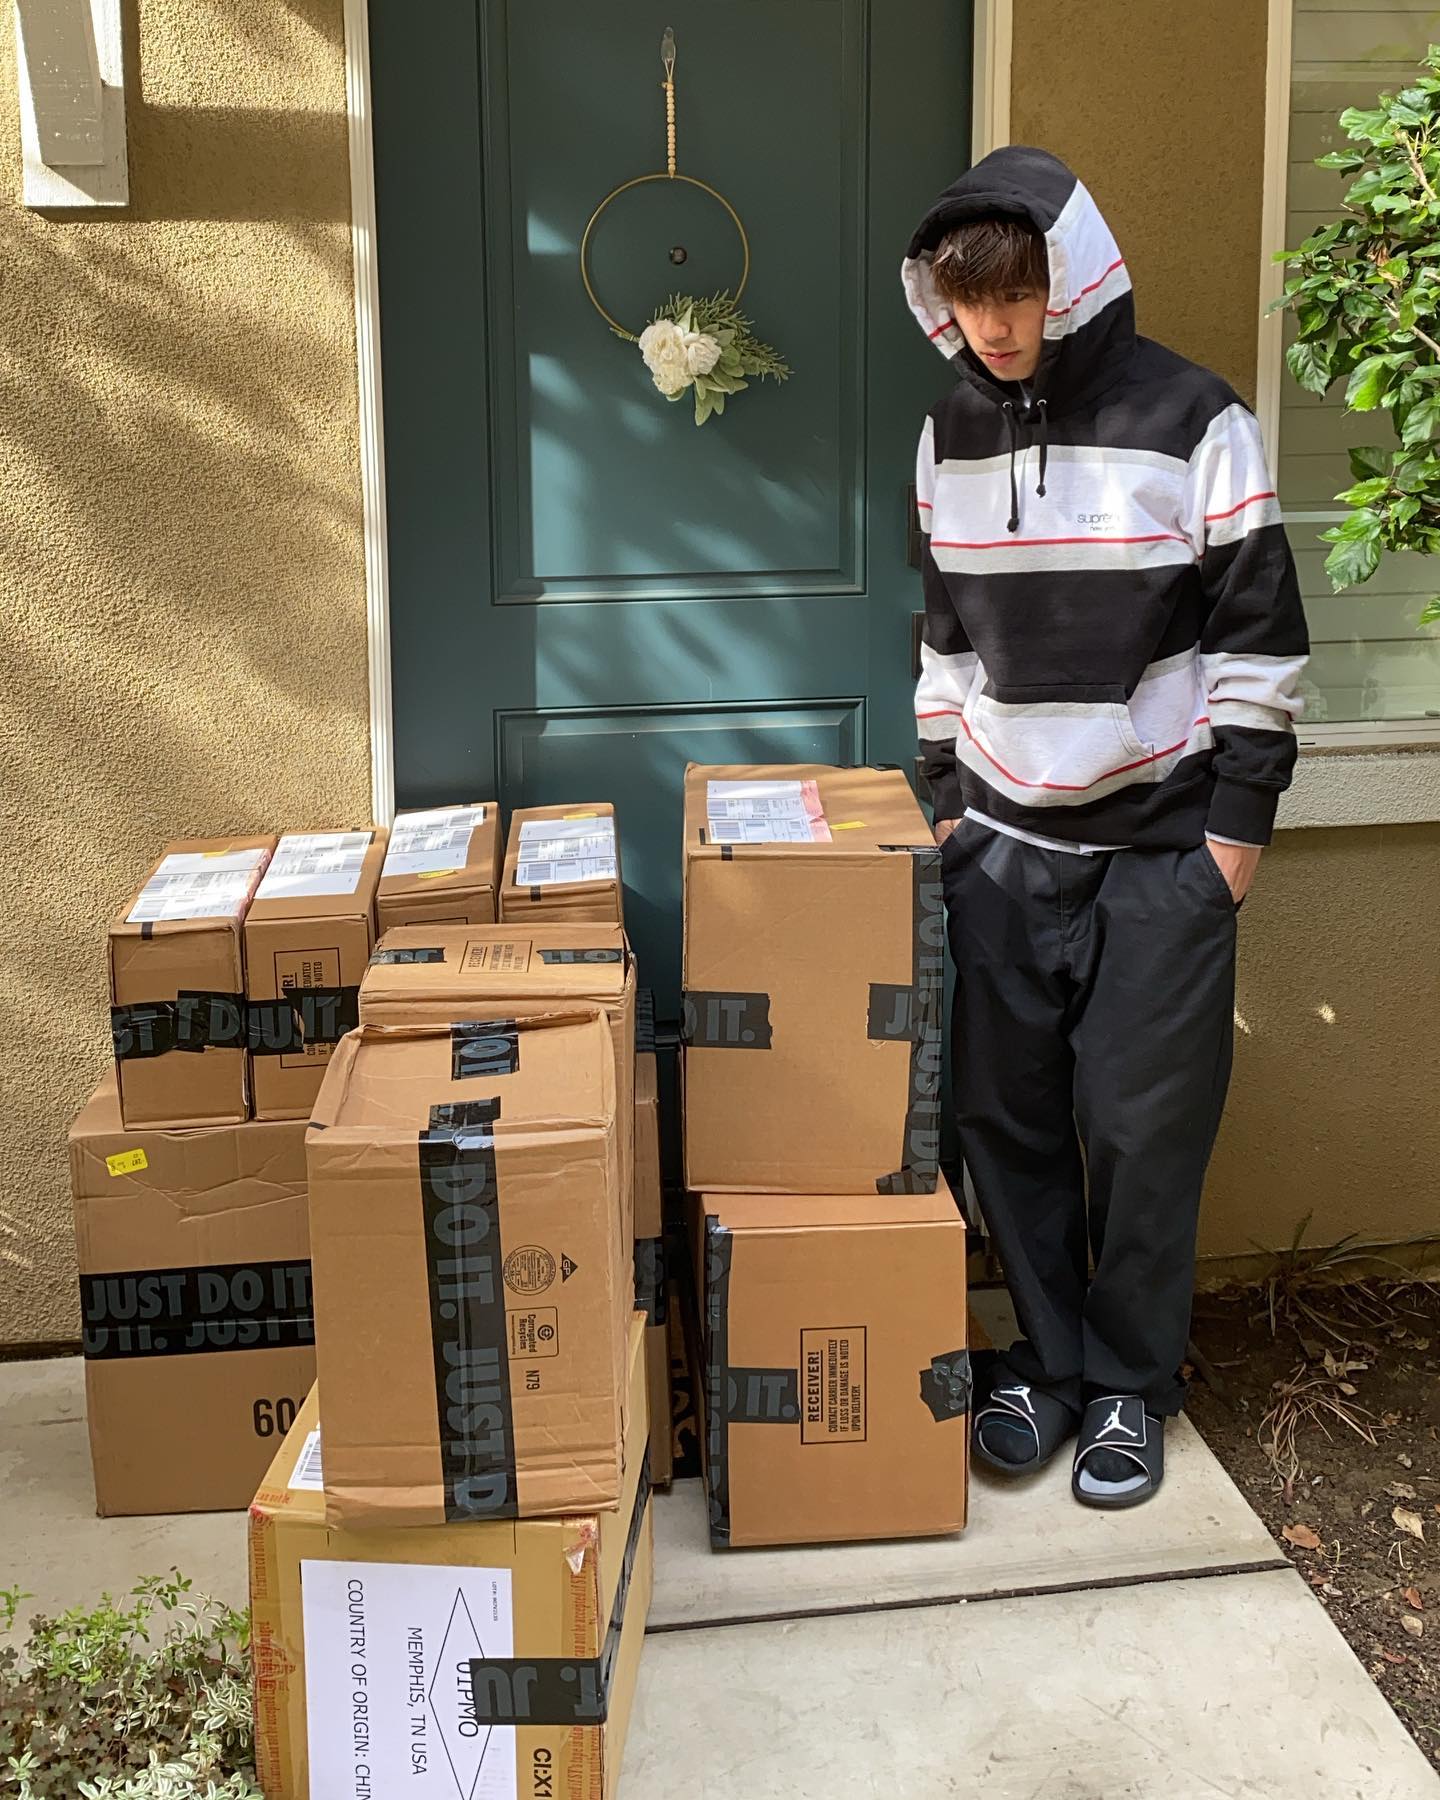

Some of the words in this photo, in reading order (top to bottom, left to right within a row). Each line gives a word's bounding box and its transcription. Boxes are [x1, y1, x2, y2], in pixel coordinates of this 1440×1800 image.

[705, 999, 756, 1043] IT.
[429, 1163, 490, 1247] DO
[562, 1259, 571, 1276] GP
[86, 1274, 187, 1322] JUST
[197, 1269, 264, 1315] DO
[436, 1256, 495, 1320] IT.
[518, 1318, 528, 1350] Recycles
[527, 1313, 538, 1353] Corrugated
[828, 1339, 838, 1379] IMMEDIATELY
[839, 1339, 849, 1360] NOTED
[839, 1361, 849, 1369] IS
[526, 1369, 541, 1391] N79
[807, 1351, 820, 1423] RECEIVER!
[828, 1379, 838, 1405] CARRIER
[839, 1370, 849, 1396] DAMAGE
[442, 1341, 506, 1461] JUST
[746, 1375, 796, 1418] IT.
[839, 1397, 849, 1407] OR
[851, 1384, 861, 1413] DELIVERY.
[252, 1397, 307, 1438] 60
[828, 1407, 838, 1433] CONTACT
[839, 1408, 849, 1424] LOSS
[851, 1414, 861, 1432] UPON
[347, 1579, 366, 1659] COUNTRY
[351, 1663, 367, 1687] OF
[407, 1627, 425, 1708] MEMPHIS,
[352, 1691, 370, 1757] ORIGIN:
[411, 1714, 426, 1737] TN
[411, 1742, 427, 1775] USA
